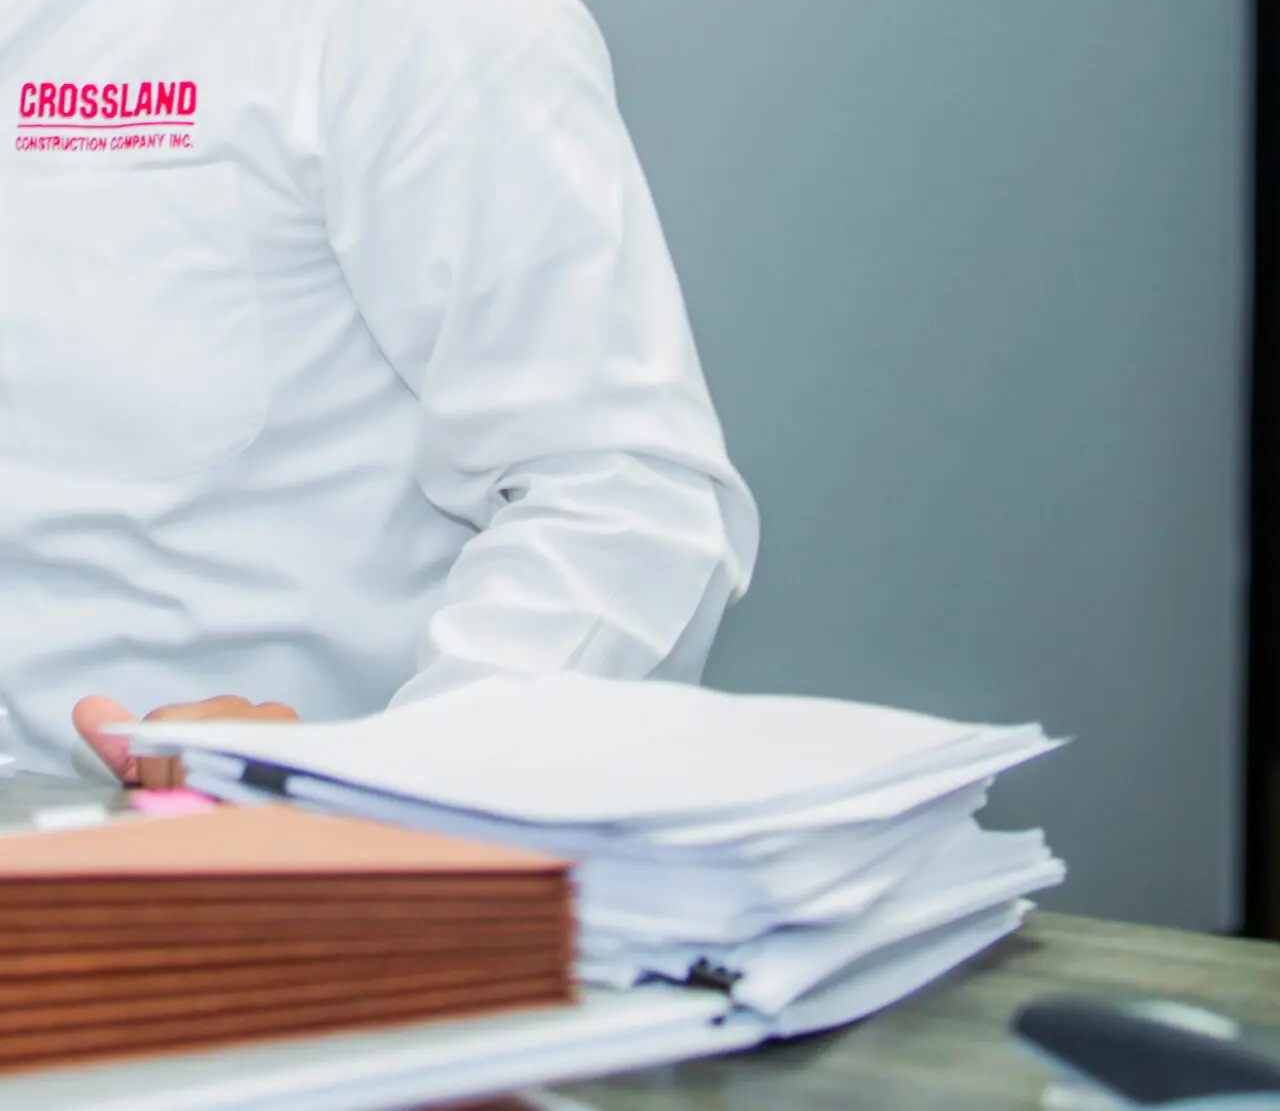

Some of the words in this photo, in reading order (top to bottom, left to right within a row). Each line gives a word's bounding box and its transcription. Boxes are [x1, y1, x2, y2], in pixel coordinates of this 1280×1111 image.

[19, 81, 198, 119] CROSSLAND
[15, 135, 108, 152] CONSTRUCTION
[110, 134, 166, 151] COMPANY
[169, 133, 194, 149] INC.
